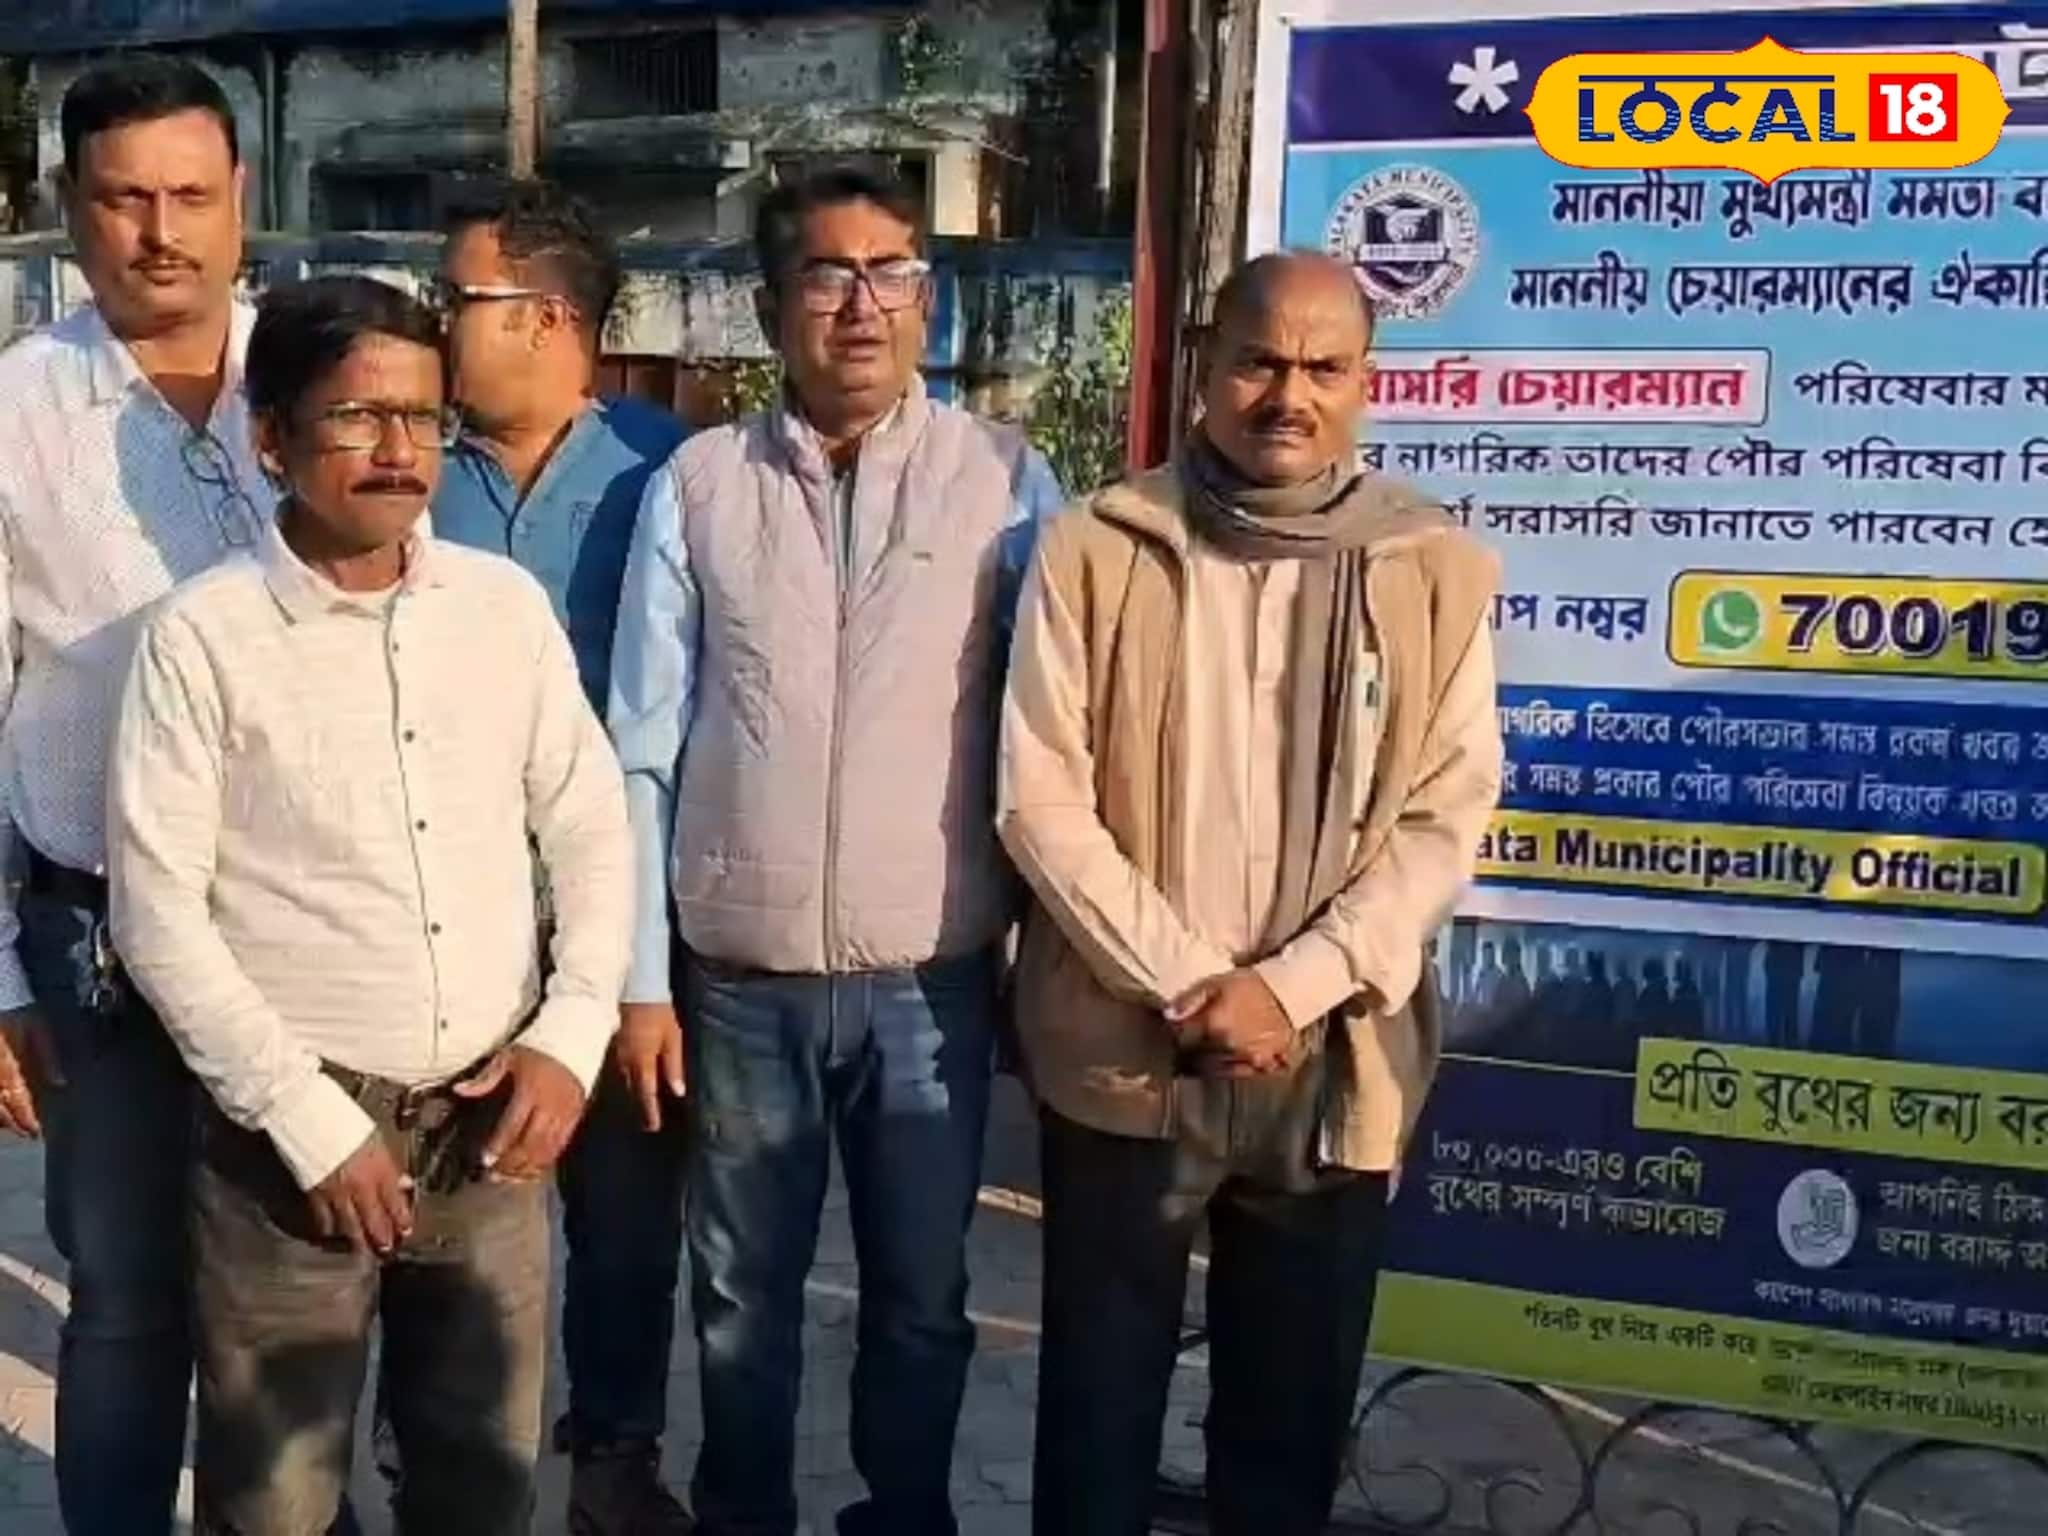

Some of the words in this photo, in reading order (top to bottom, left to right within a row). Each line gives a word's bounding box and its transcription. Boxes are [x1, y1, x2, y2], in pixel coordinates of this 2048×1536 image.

[1552, 168, 1704, 230] মাননীয়া
[1720, 168, 1872, 238] মুখ্যমন্ত্রী
[1886, 176, 1996, 219] মমতা
[1509, 250, 1648, 316] মাননীয়
[1667, 266, 1912, 317] চেয়ারম্যানের
[1499, 369, 1746, 412] চেয়ারম্যান
[1794, 359, 2010, 406] পরিষেবার
[1397, 431, 1550, 473] নাগরিক
[1562, 443, 1692, 476] তাদের
[1706, 434, 1806, 477] পৌর
[1822, 435, 2006, 482] পরিষেবা
[1486, 495, 1640, 537] সরাসরি
[1650, 507, 1814, 542] জানাতে
[1826, 510, 1995, 546] পারবেন
[1555, 595, 1648, 641] নম্বর
[1780, 592, 2048, 662] 70019
[1555, 828, 1832, 893] Municipality
[1853, 847, 2021, 897] Official
[1649, 1048, 1741, 1112] প্রতি
[1753, 1070, 1873, 1134] বুথের
[1889, 1086, 1982, 1145] জন্য
[1428, 1171, 1502, 1215] বুথের
[1635, 1147, 1703, 1197] বেশি
